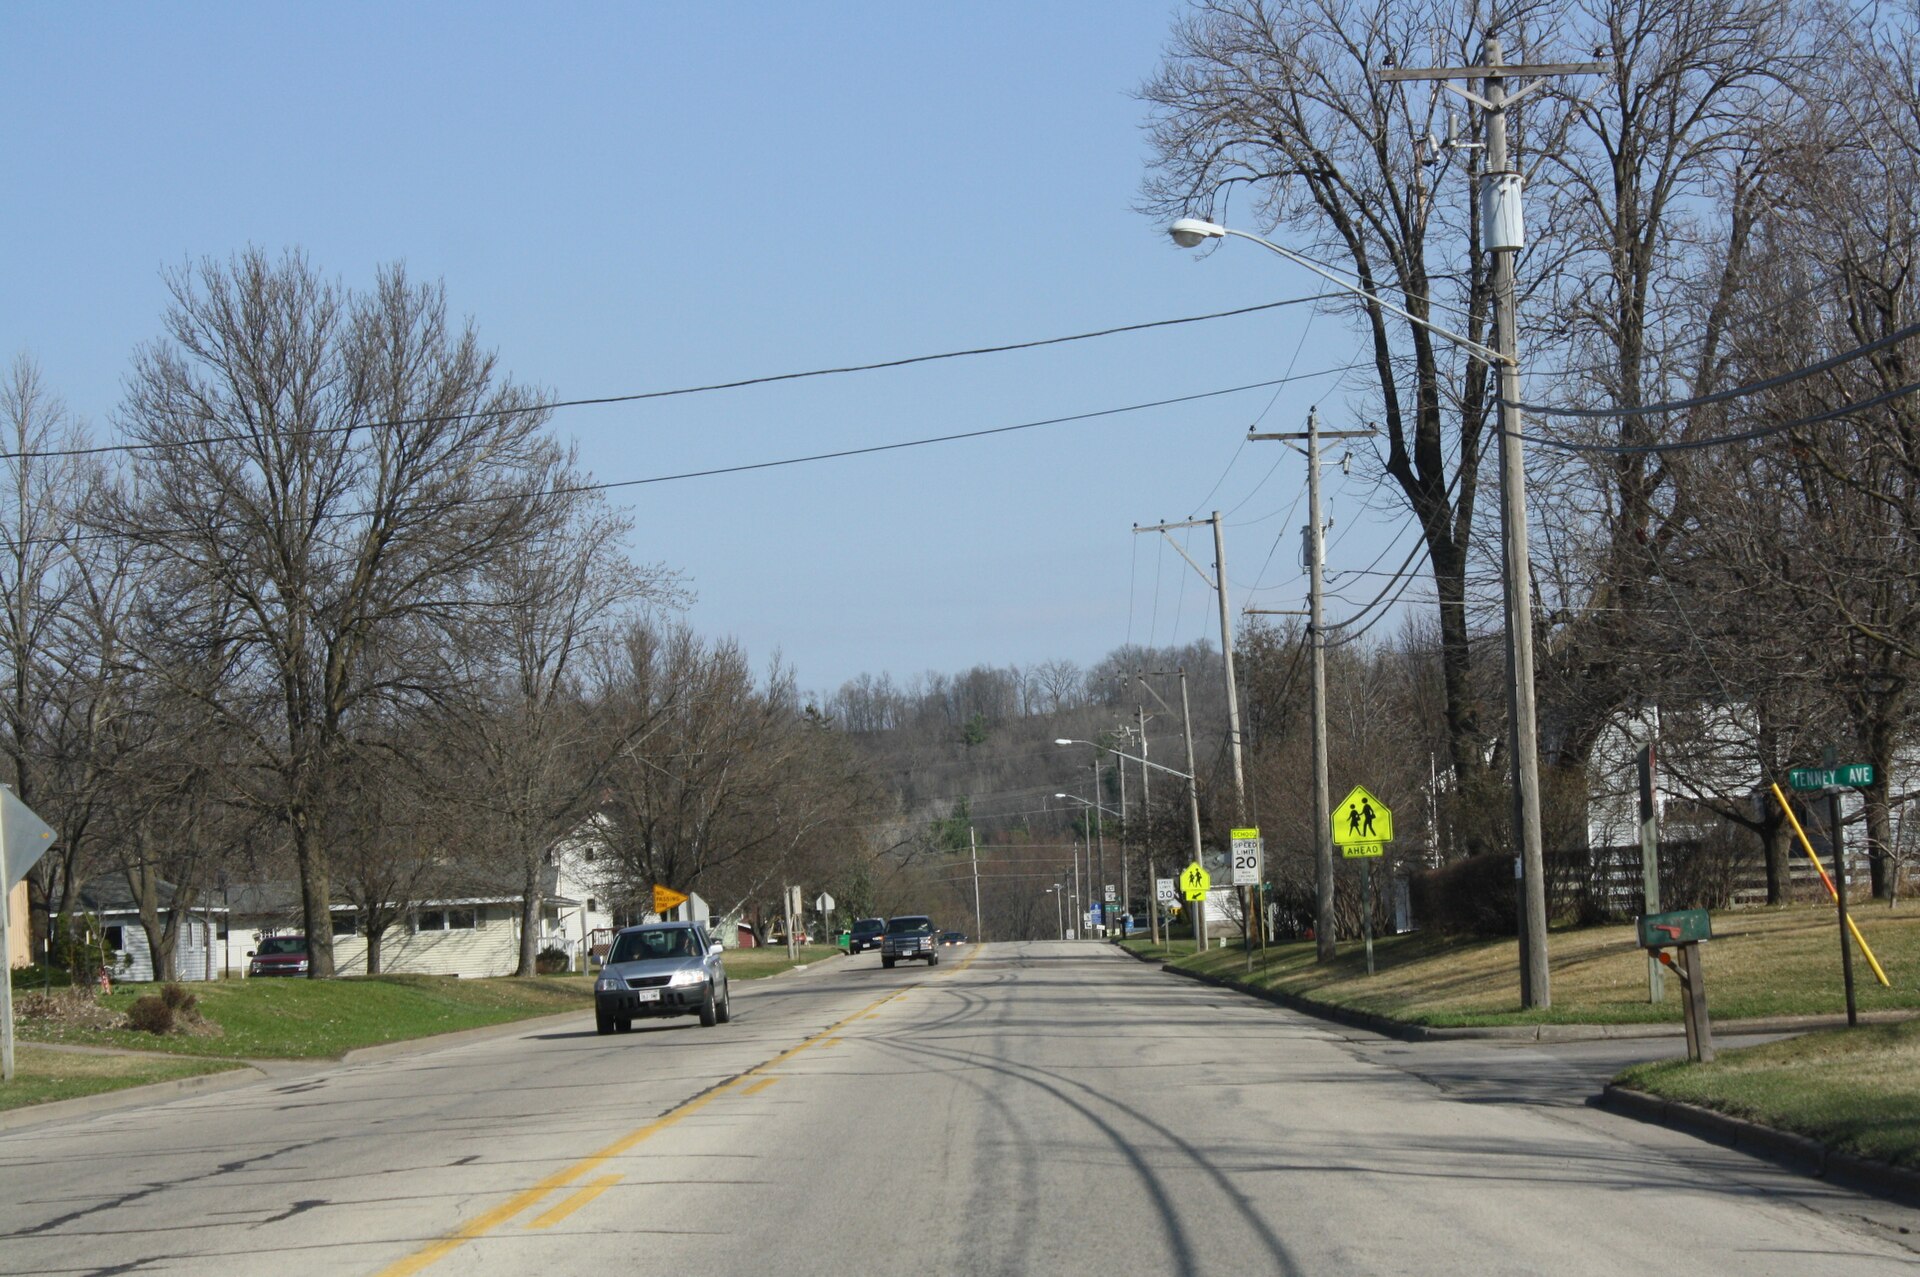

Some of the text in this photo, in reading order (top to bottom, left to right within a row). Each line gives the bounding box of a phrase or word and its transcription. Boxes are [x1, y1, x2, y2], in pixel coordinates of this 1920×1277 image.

[1793, 767, 1870, 787] TENNEY AVE
[1347, 845, 1379, 855] AHEAD
[1235, 856, 1256, 869] 20
[1159, 890, 1172, 898] 30
